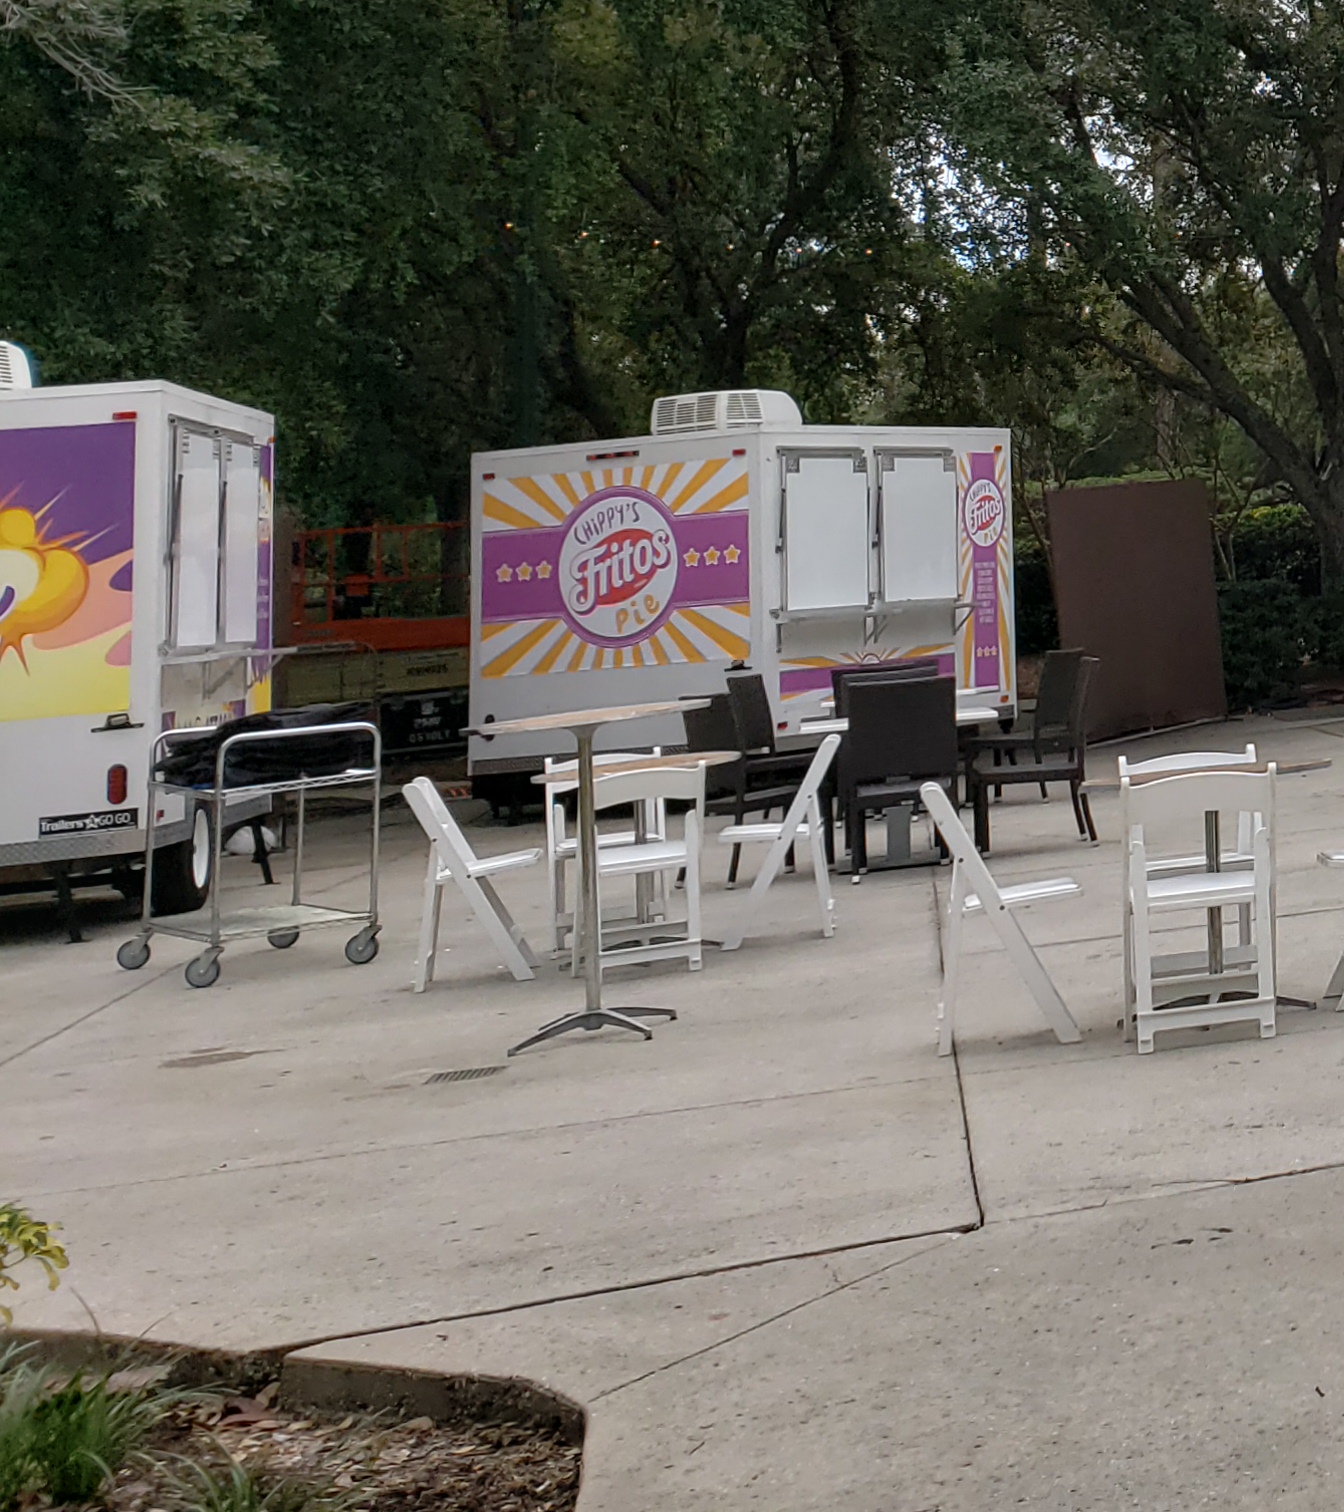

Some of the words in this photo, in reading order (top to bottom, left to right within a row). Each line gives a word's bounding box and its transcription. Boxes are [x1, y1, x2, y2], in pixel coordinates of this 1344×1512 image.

[970, 497, 1002, 535] Fritos
[569, 529, 671, 615] Fritos
[99, 814, 114, 826] GO
[115, 812, 131, 824] GO
